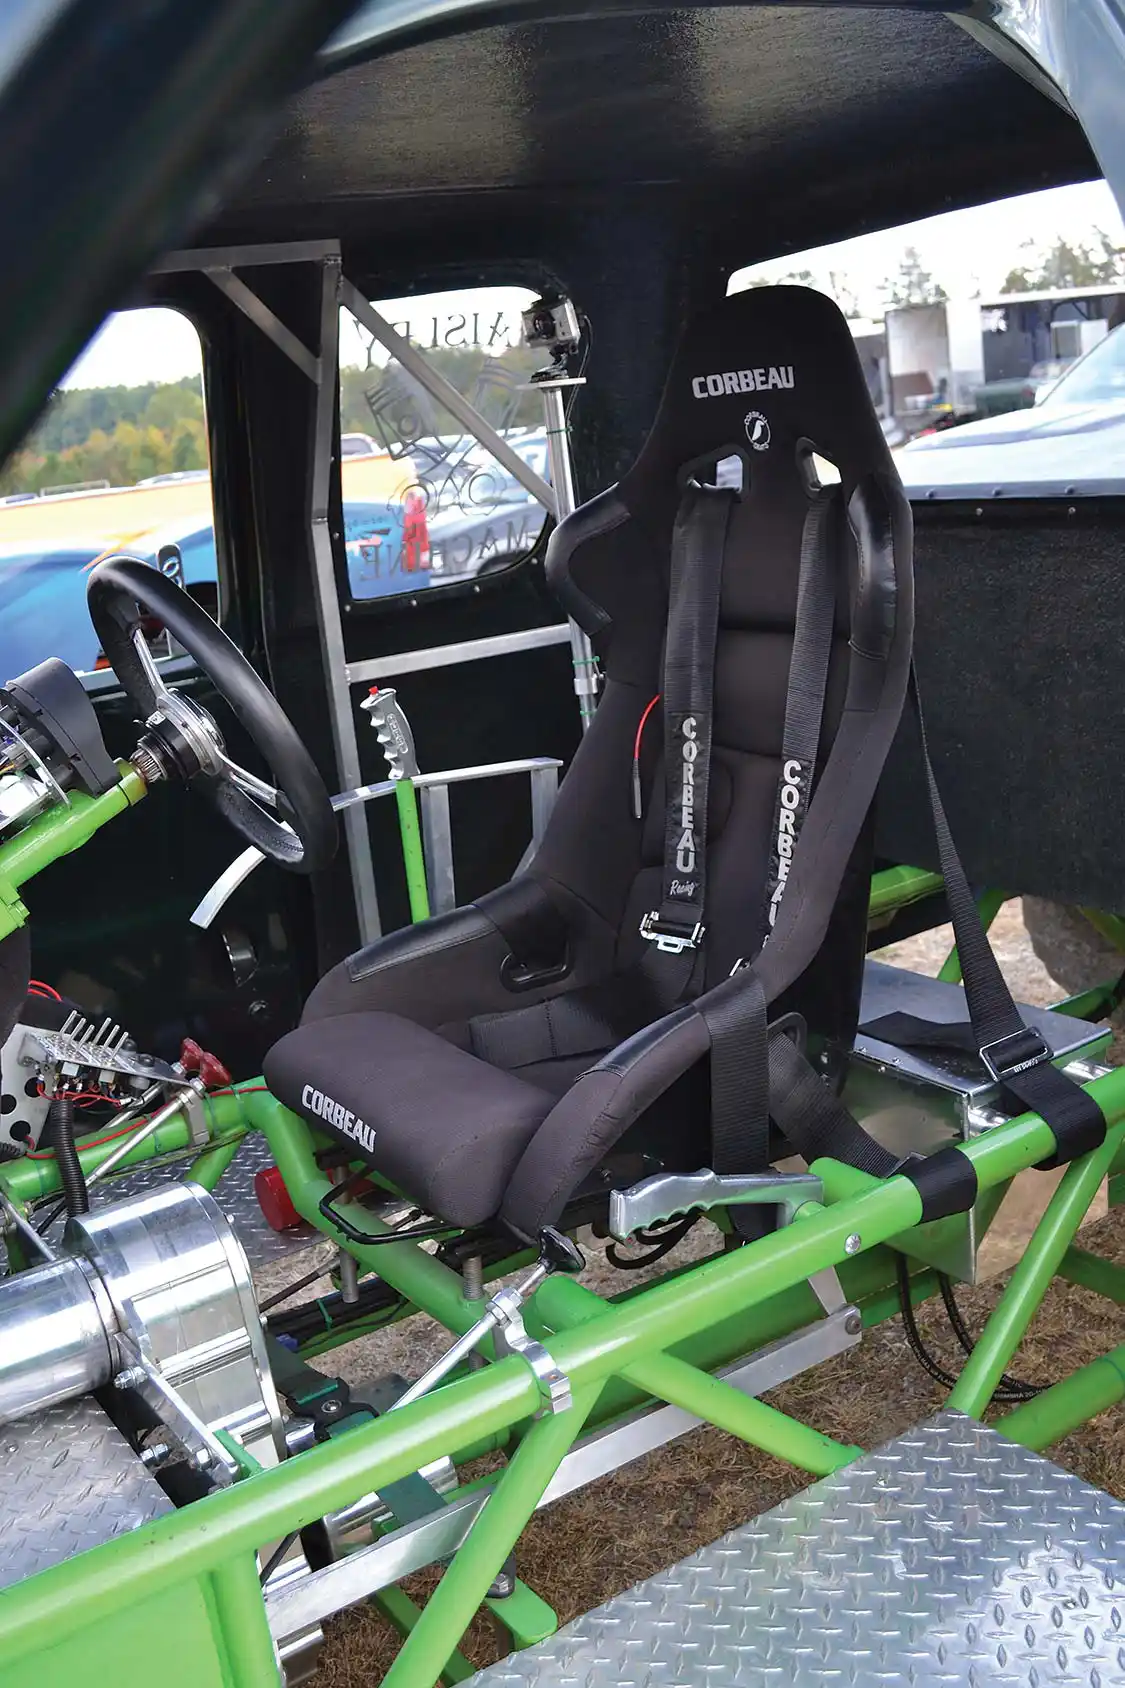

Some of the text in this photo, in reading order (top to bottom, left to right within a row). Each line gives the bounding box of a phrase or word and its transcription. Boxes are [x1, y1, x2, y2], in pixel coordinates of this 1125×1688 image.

[692, 366, 795, 399] CORBEAU
[676, 716, 698, 873] CORBEAU
[301, 1084, 377, 1153] CORBEAU
